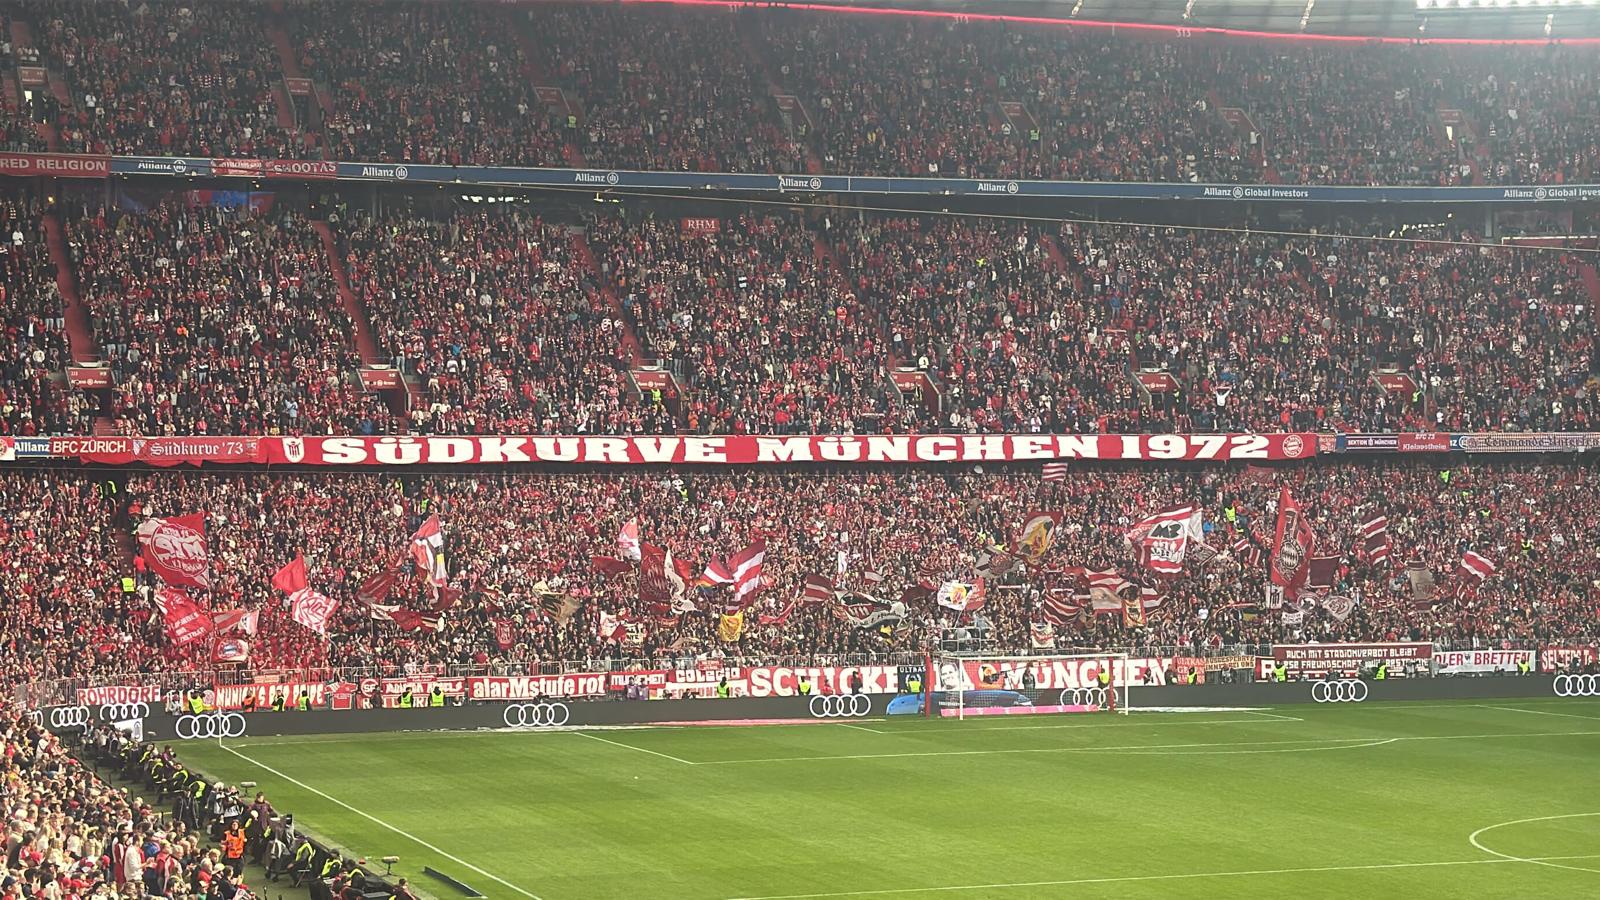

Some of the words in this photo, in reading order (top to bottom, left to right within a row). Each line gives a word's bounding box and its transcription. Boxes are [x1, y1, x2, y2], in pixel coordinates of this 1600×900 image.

[0, 158, 30, 169] RED
[36, 158, 107, 171] RELIGION
[362, 166, 395, 177] Allianz
[574, 173, 606, 183] Allianz
[779, 177, 809, 187] Allianz
[977, 182, 1006, 192] Allianz
[1203, 187, 1232, 197] Allianz
[1244, 188, 1271, 198] Global
[1271, 188, 1309, 198] Investors
[1503, 189, 1534, 198] Allianz
[1548, 188, 1577, 198] Global
[687, 219, 716, 229] RHM
[14, 441, 50, 452] Allianz
[52, 441, 79, 453] BFC
[80, 439, 126, 453] ZÜRICH
[150, 441, 220, 456] Südkurve
[222, 441, 244, 455] '73
[322, 436, 727, 464] SÜDKURVE
[757, 434, 1101, 462] MÜNCHEN
[1120, 433, 1269, 459] 1972
[1474, 651, 1531, 666] BRETTEN
[473, 676, 575, 698] alarMstufe
[577, 674, 606, 695] rot
[77, 685, 160, 705] ROHRDORF
